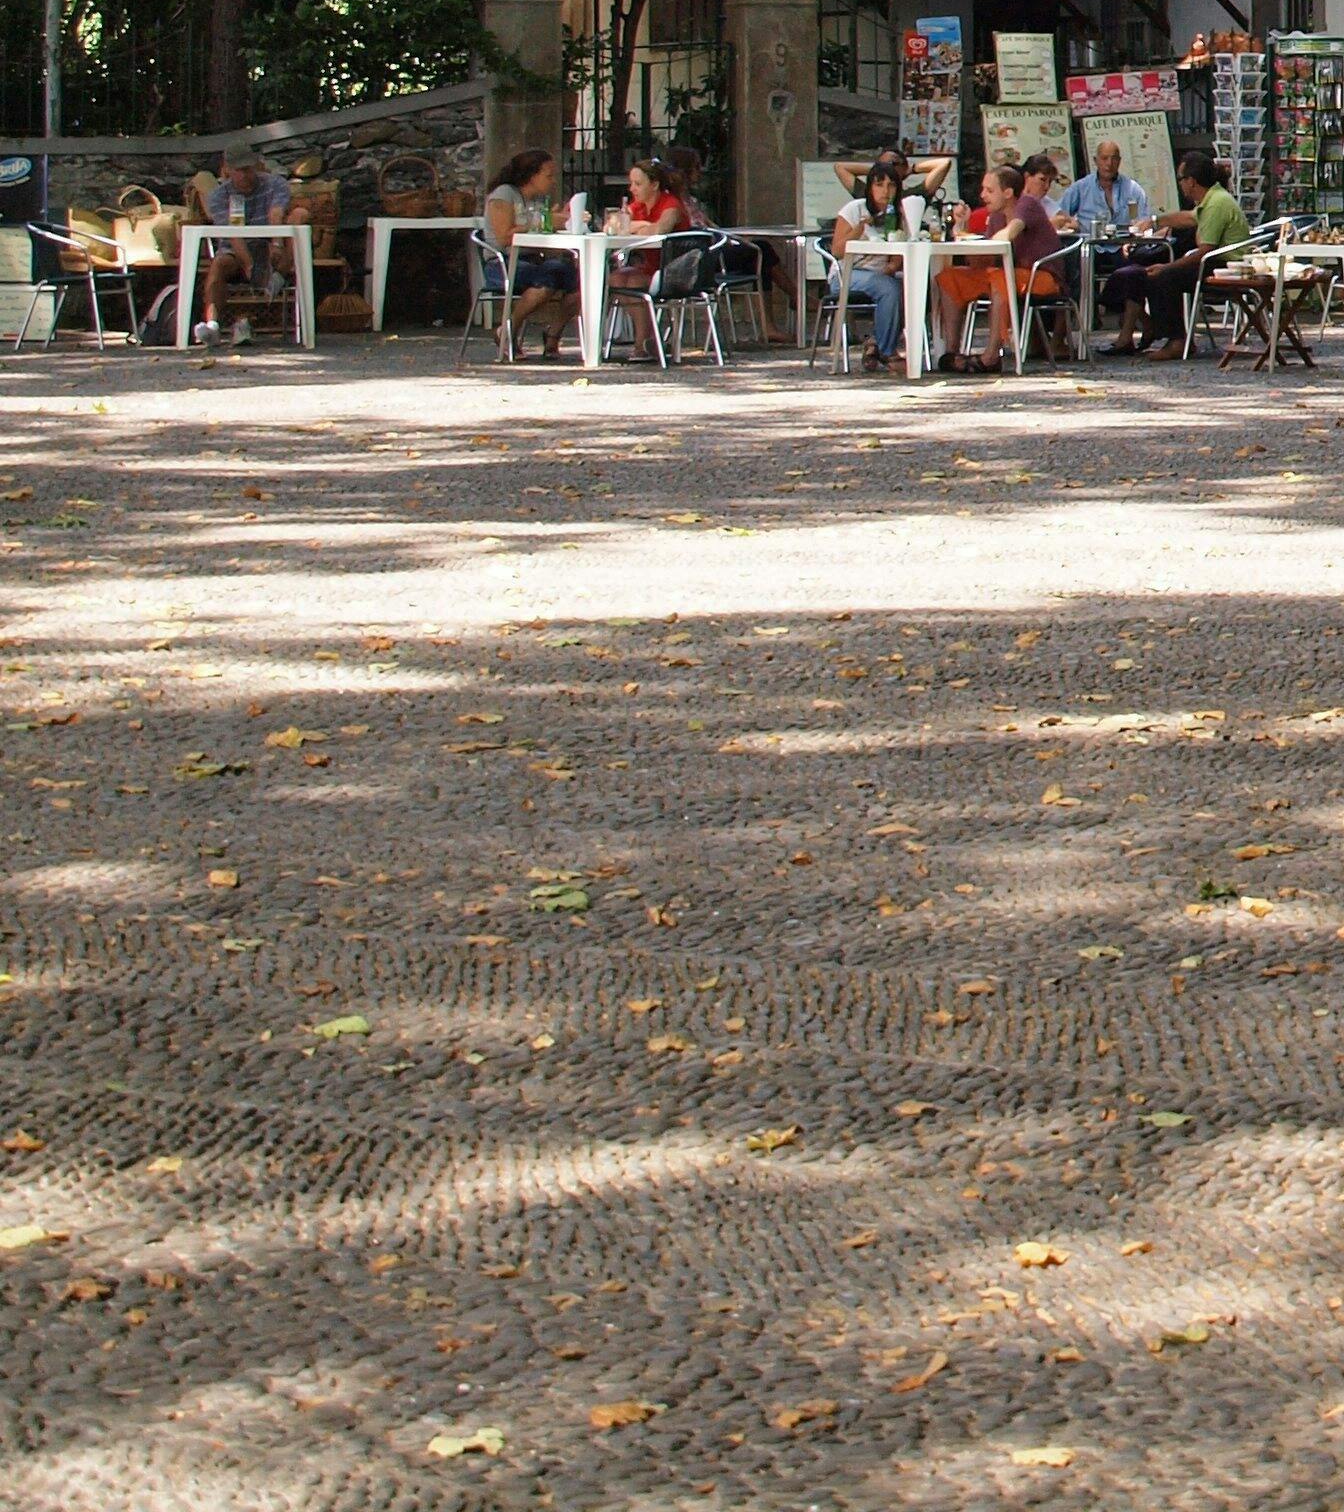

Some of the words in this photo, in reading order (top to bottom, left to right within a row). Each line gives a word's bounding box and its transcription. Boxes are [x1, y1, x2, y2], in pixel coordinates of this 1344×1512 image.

[1011, 109, 1026, 118] DO
[1027, 108, 1066, 119] PARQUE
[1110, 118, 1125, 129] DO
[1126, 114, 1166, 129] PARQUE
